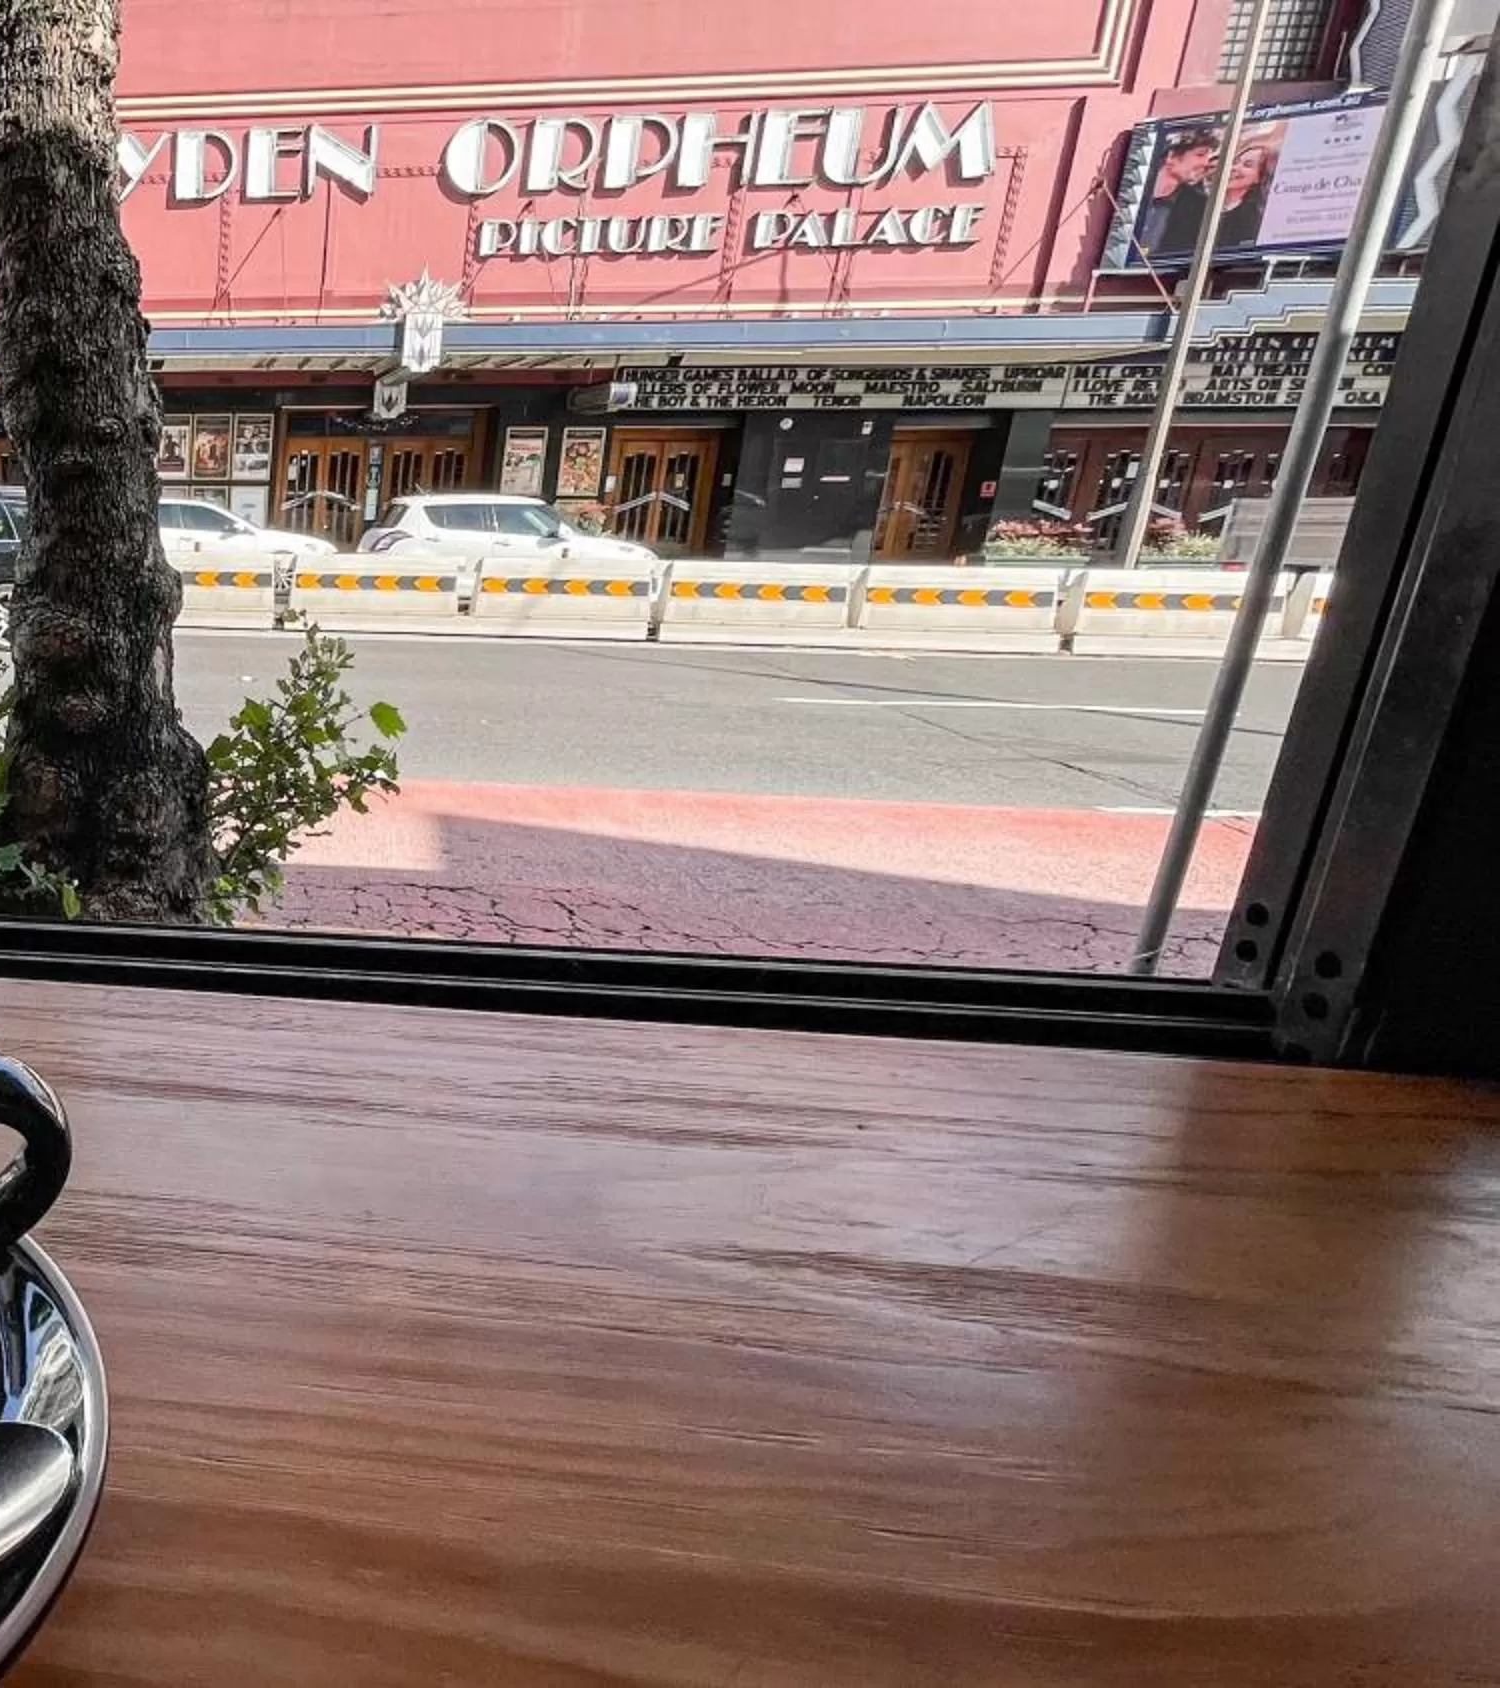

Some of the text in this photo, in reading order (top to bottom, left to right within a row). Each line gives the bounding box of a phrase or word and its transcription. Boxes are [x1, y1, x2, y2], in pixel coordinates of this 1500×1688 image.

[445, 98, 996, 194] ORPHEUM
[479, 205, 981, 257] PICTURE PALACE
[1217, 338, 1282, 348] AYDEN
[683, 368, 735, 381] GAMES
[738, 369, 797, 381] BALLAD
[807, 369, 828, 381] OF
[1074, 365, 1163, 378] MET OPER
[1210, 364, 1245, 376] NAT
[637, 383, 687, 394] ILLERS
[691, 383, 712, 394] OF
[789, 382, 836, 394] MOON
[863, 381, 940, 394] MAESTRO
[959, 380, 1042, 393] SALTBURN
[1083, 380, 1125, 392] LOVE
[1205, 379, 1252, 391] ARTS
[1256, 379, 1281, 391] ON
[657, 396, 687, 408] BOY
[689, 396, 701, 407] &
[706, 396, 733, 407] THE
[737, 396, 789, 407] HERON
[901, 394, 987, 407] NAPOLEON
[1088, 394, 1119, 405] THE
